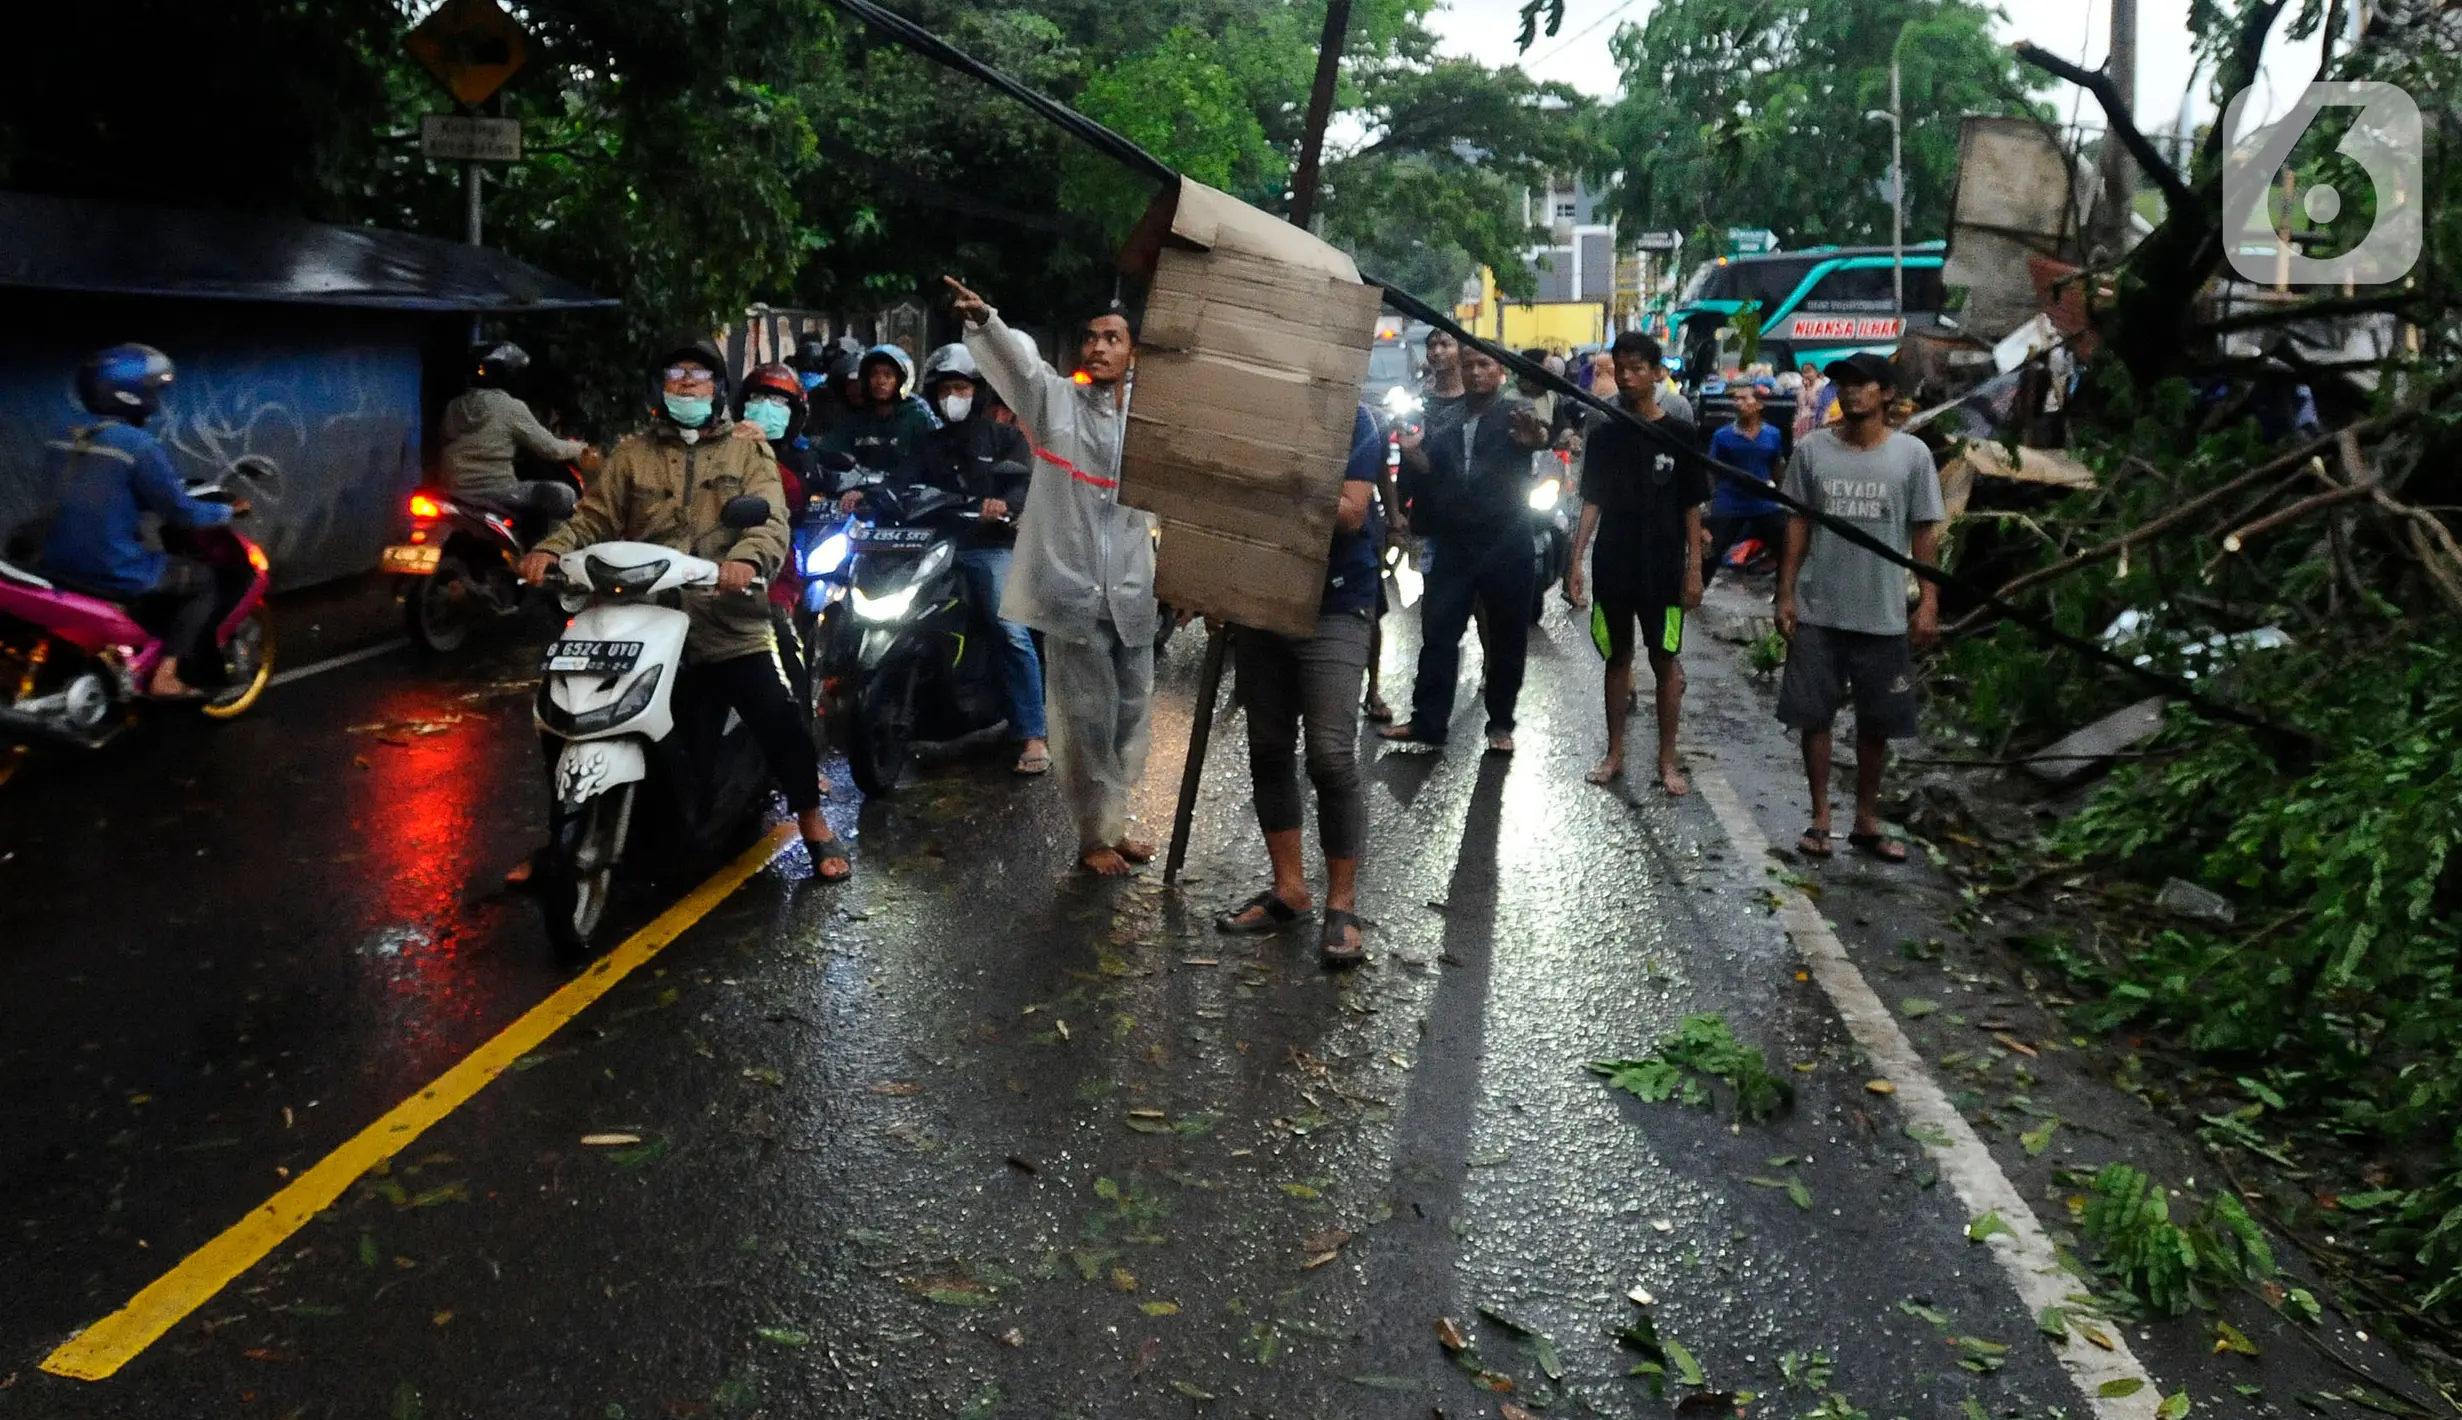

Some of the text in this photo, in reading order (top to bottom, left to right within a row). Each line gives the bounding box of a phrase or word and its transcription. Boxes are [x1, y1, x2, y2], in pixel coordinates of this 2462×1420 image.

[1793, 319, 1855, 339] NUANSA
[1821, 480, 1886, 498] NEVADA
[1824, 500, 1881, 518] JEANS
[562, 642, 602, 656] 6524
